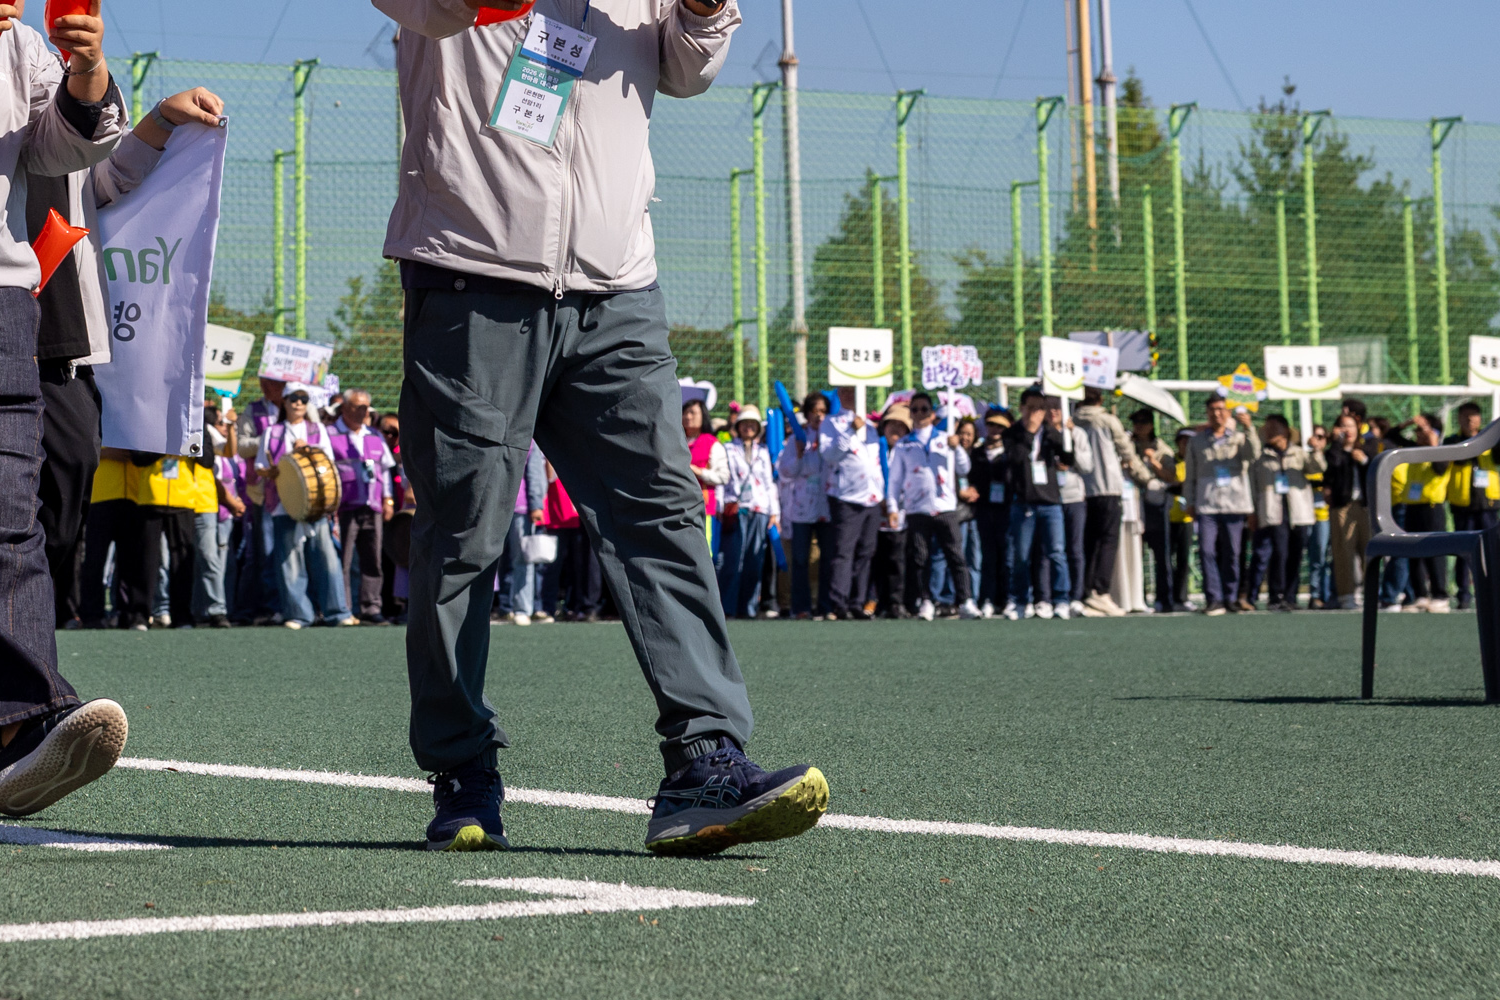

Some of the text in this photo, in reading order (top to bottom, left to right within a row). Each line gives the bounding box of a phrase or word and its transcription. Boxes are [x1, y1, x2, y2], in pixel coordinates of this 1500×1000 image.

[521, 66, 537, 76] 2026
[521, 74, 539, 84] 한마음
[205, 345, 234, 366] 1동
